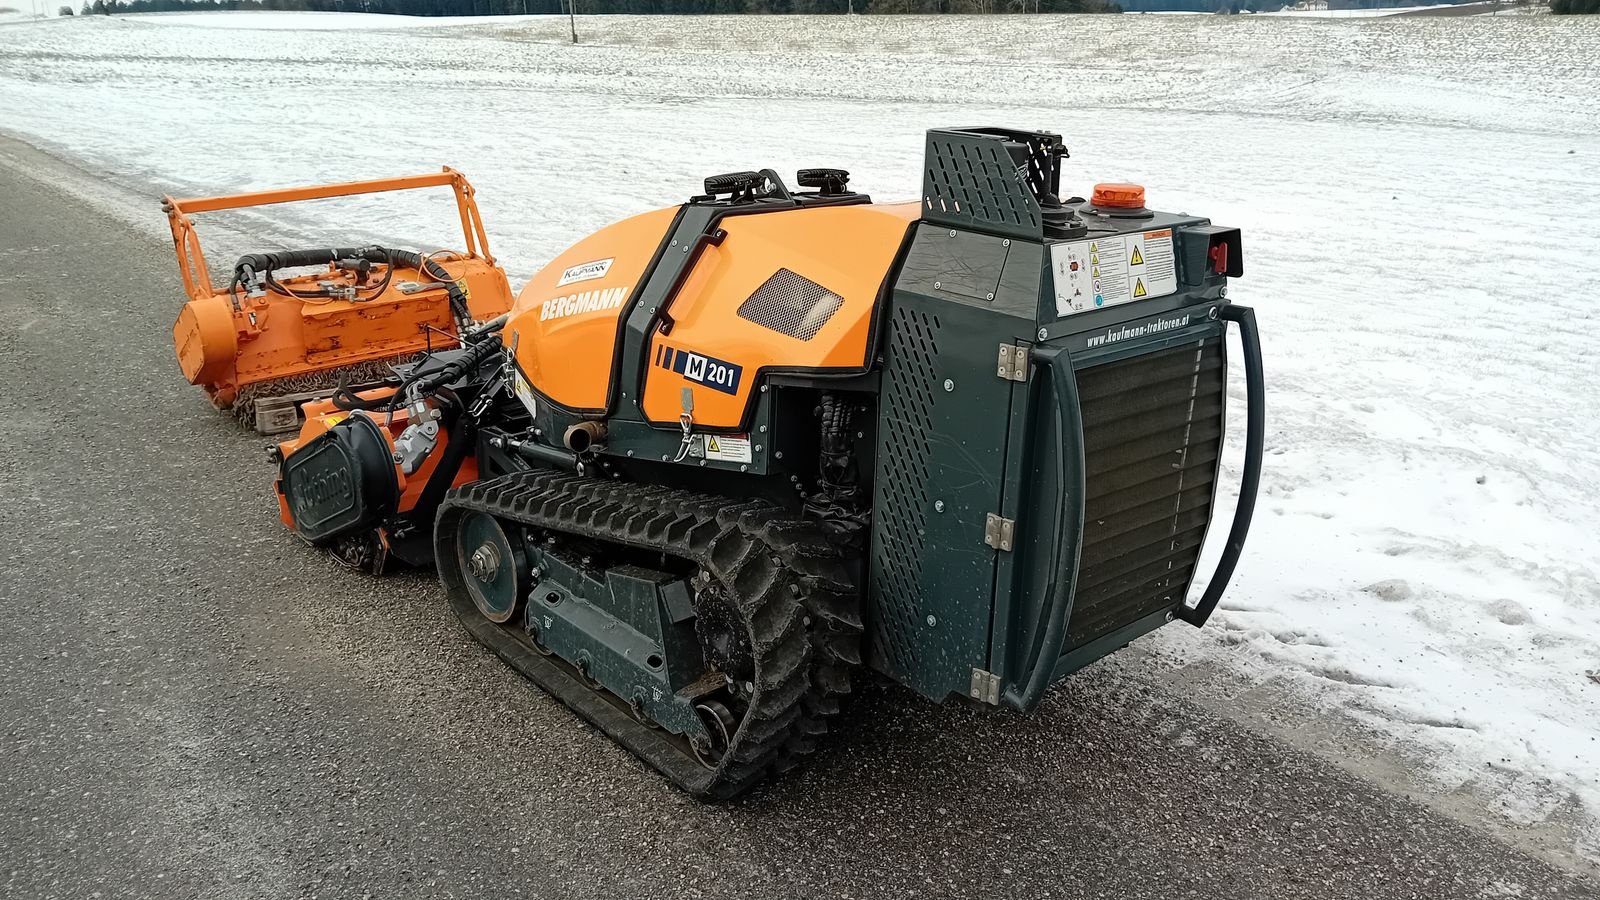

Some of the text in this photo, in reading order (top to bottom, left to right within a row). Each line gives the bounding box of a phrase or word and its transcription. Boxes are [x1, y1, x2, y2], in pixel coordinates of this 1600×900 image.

[540, 287, 628, 322] BERGMANN
[1087, 314, 1190, 347] www.kaufmann-traktoren.at
[689, 357, 734, 387] M 201
